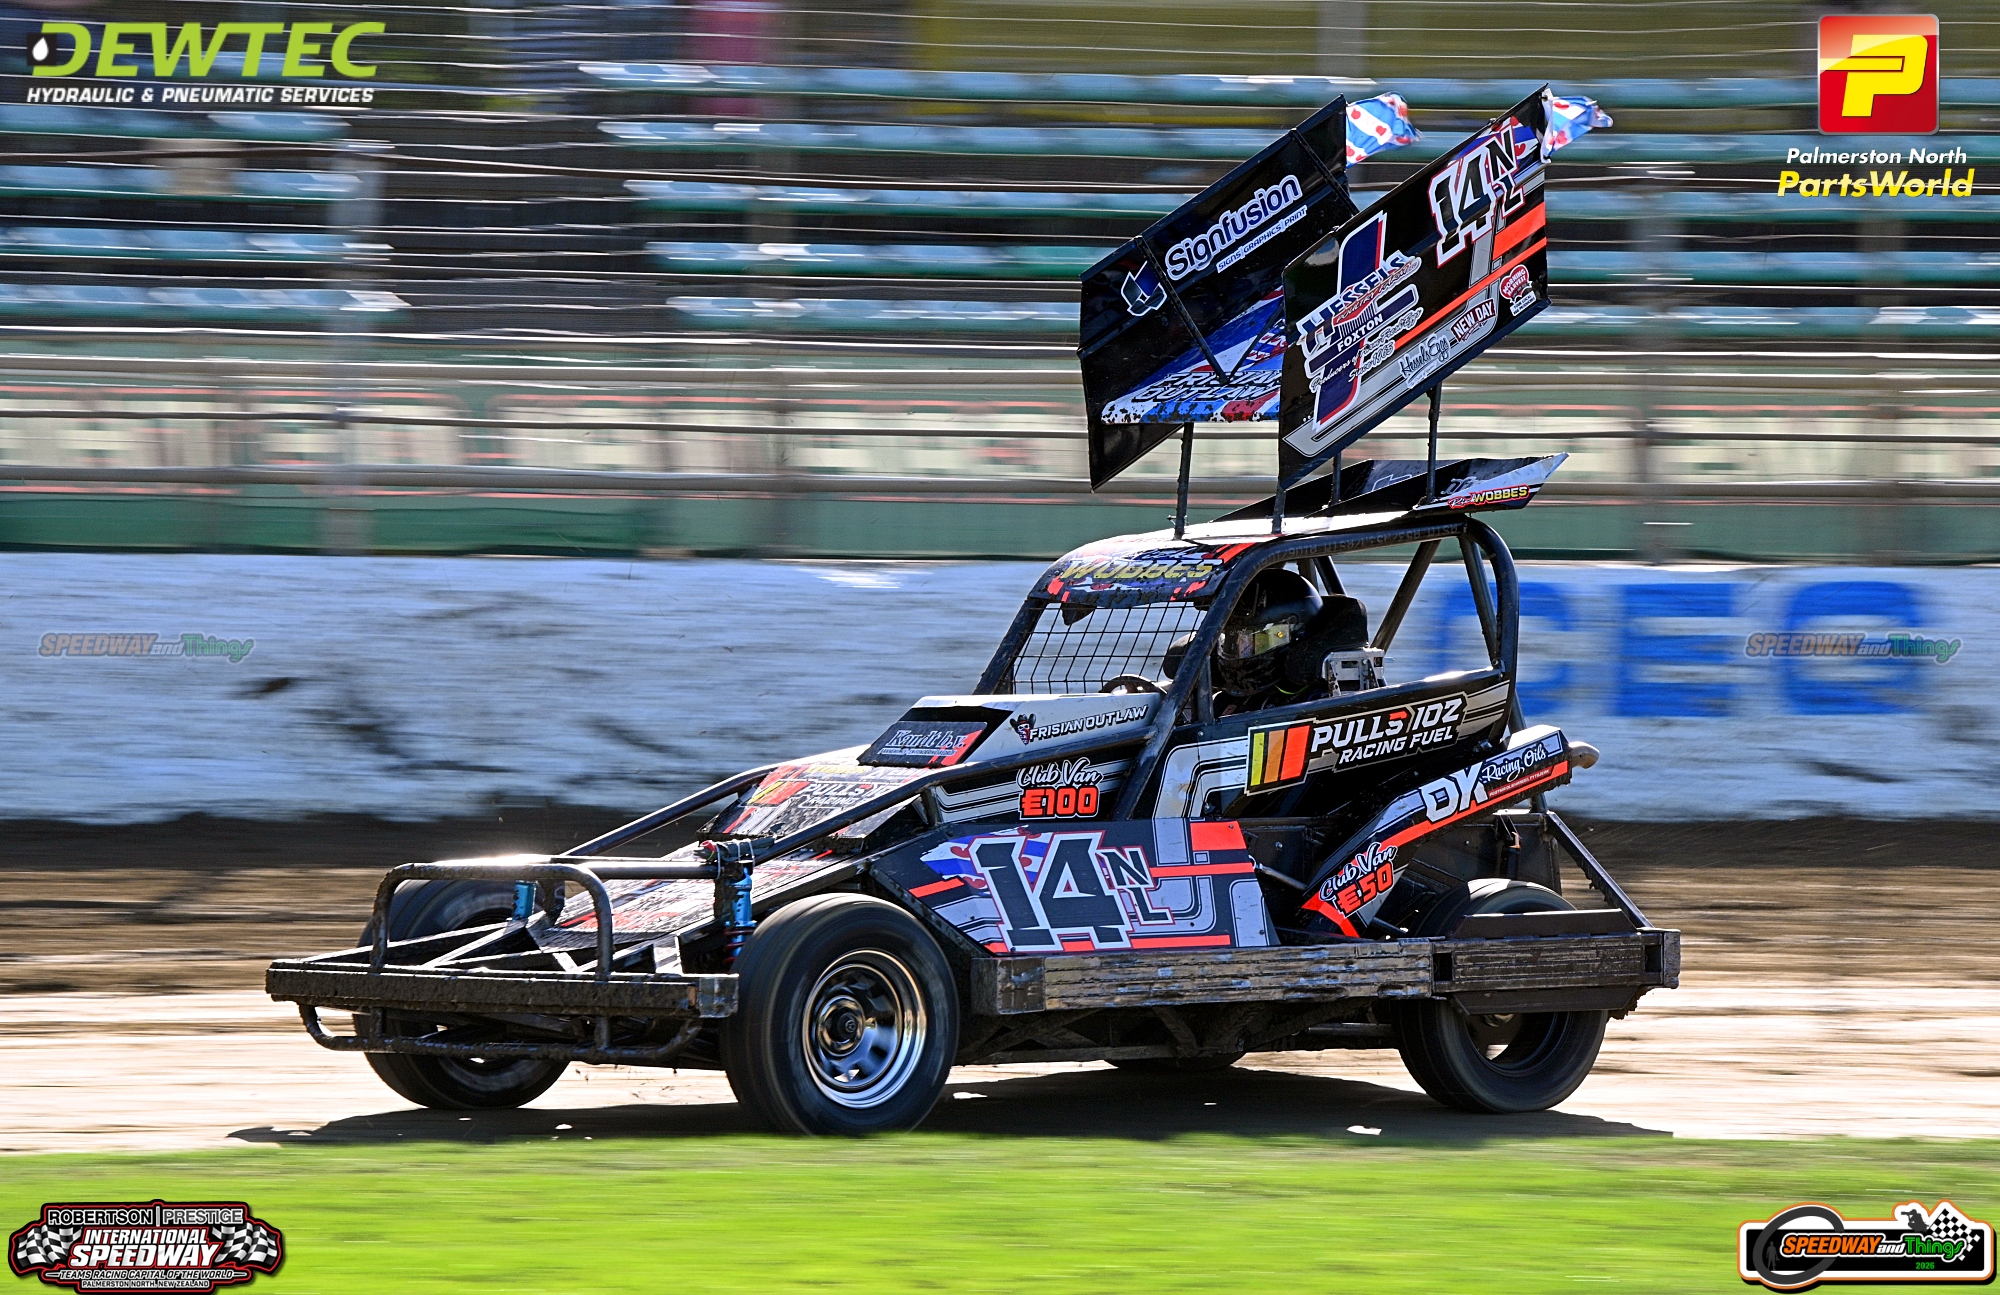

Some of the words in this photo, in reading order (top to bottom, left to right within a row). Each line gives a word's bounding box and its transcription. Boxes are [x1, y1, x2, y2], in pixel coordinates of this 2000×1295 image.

[1166, 176, 1302, 279] Signfusion
[1243, 224, 1282, 254] GRAPHICS
[1300, 255, 1407, 354] HESSELS
[1453, 311, 1476, 339] NEW
[1475, 301, 1495, 323] DAY
[1337, 314, 1383, 352] FOXTON
[1428, 335, 1450, 362] Eggs
[1475, 486, 1528, 503] WOBBES
[1029, 721, 1084, 741] FRISIAN
[1085, 704, 1149, 731] OUTLAW
[1339, 740, 1403, 764] RACING
[1410, 725, 1454, 749] FUEL
[1482, 757, 1524, 783] Racing
[1523, 743, 1547, 768] Oils
[1018, 763, 1060, 787] Club
[1061, 759, 1102, 786] Van
[968, 830, 1134, 951] 14
[1320, 861, 1357, 901] Club
[1356, 842, 1399, 878] Van
